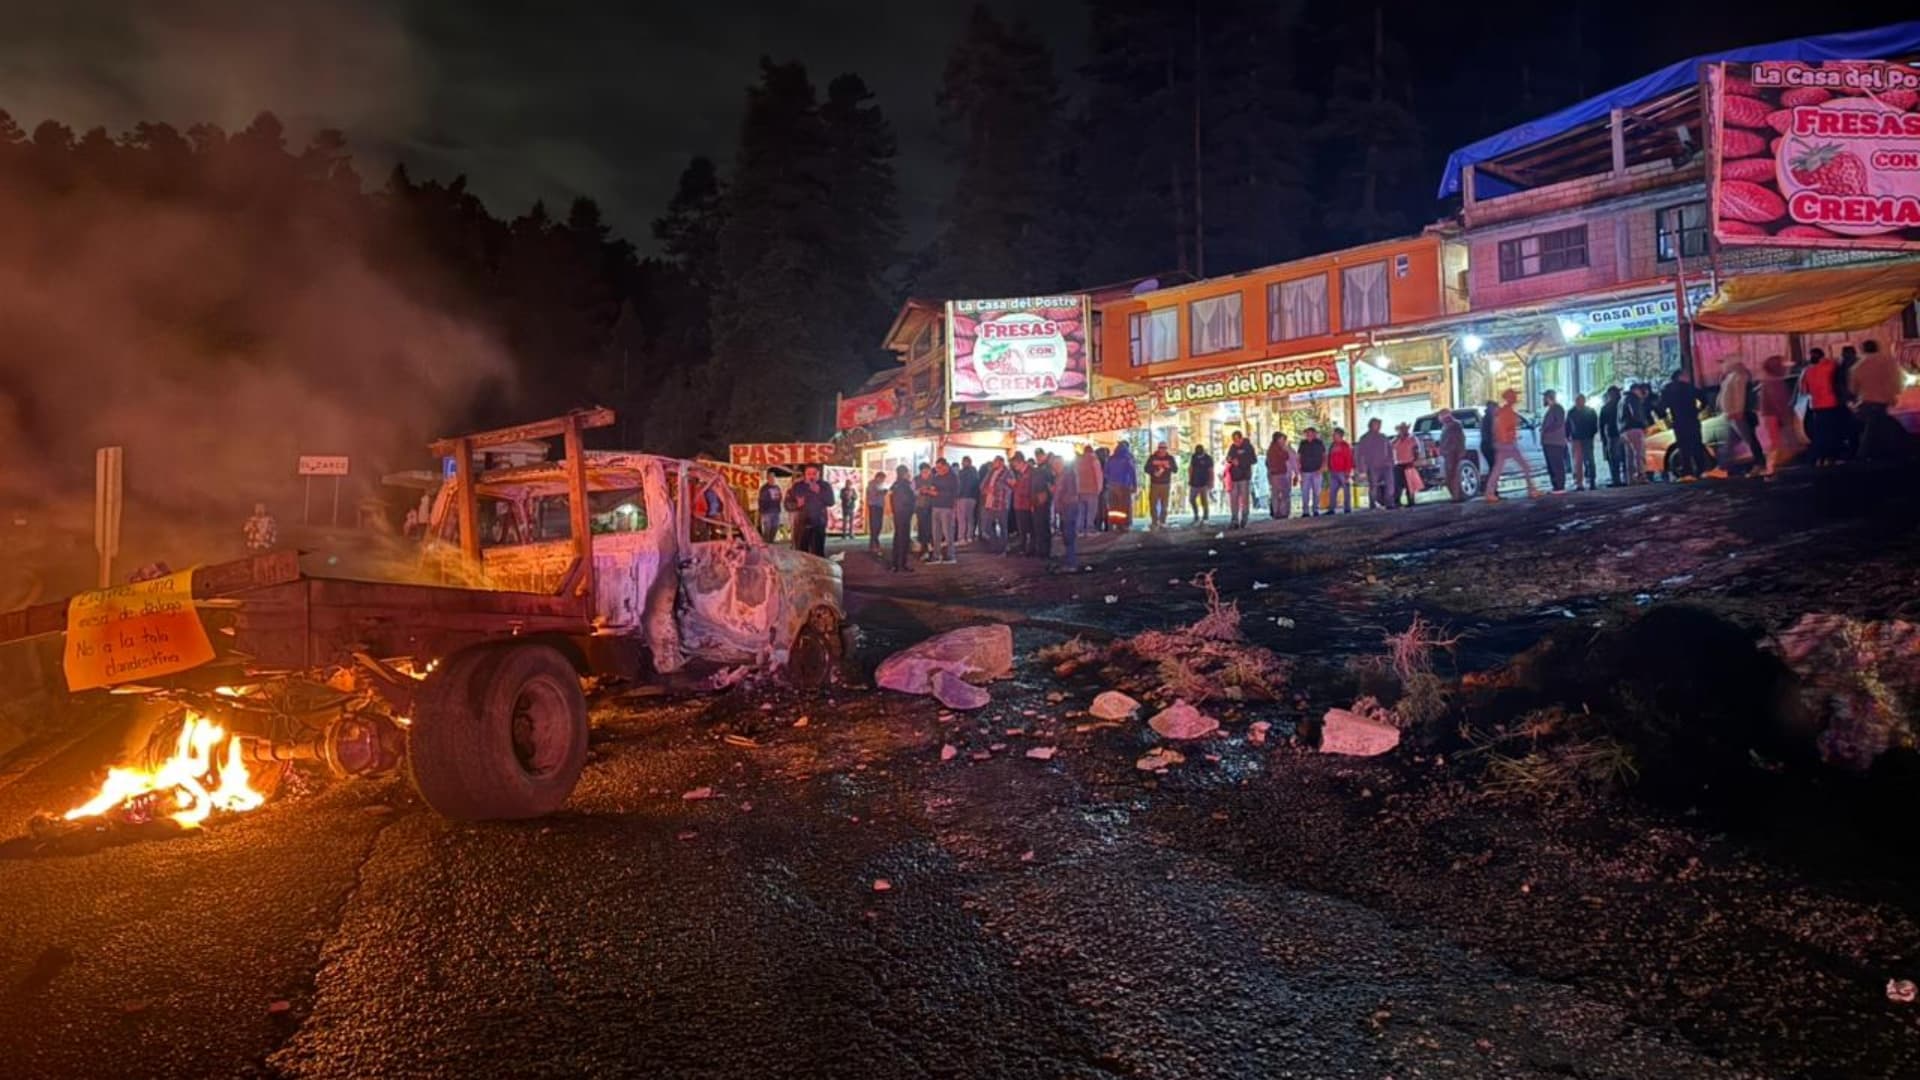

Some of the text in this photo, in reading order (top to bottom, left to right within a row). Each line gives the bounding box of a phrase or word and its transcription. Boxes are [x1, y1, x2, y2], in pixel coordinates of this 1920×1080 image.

[1755, 66, 1920, 88] La Casa del Po
[1796, 109, 1920, 135] FRESAS
[1874, 154, 1917, 167] CON
[1792, 194, 1920, 222] CREMA
[958, 297, 1077, 310] La Casa del Postre
[1592, 304, 1655, 322] CASA DE
[983, 322, 1056, 338] FRESAS
[986, 376, 1056, 390] CREMA
[1164, 368, 1326, 402] La Casa del Postre
[732, 444, 834, 464] PASTES
[76, 640, 95, 659] No
[119, 631, 134, 649] la
